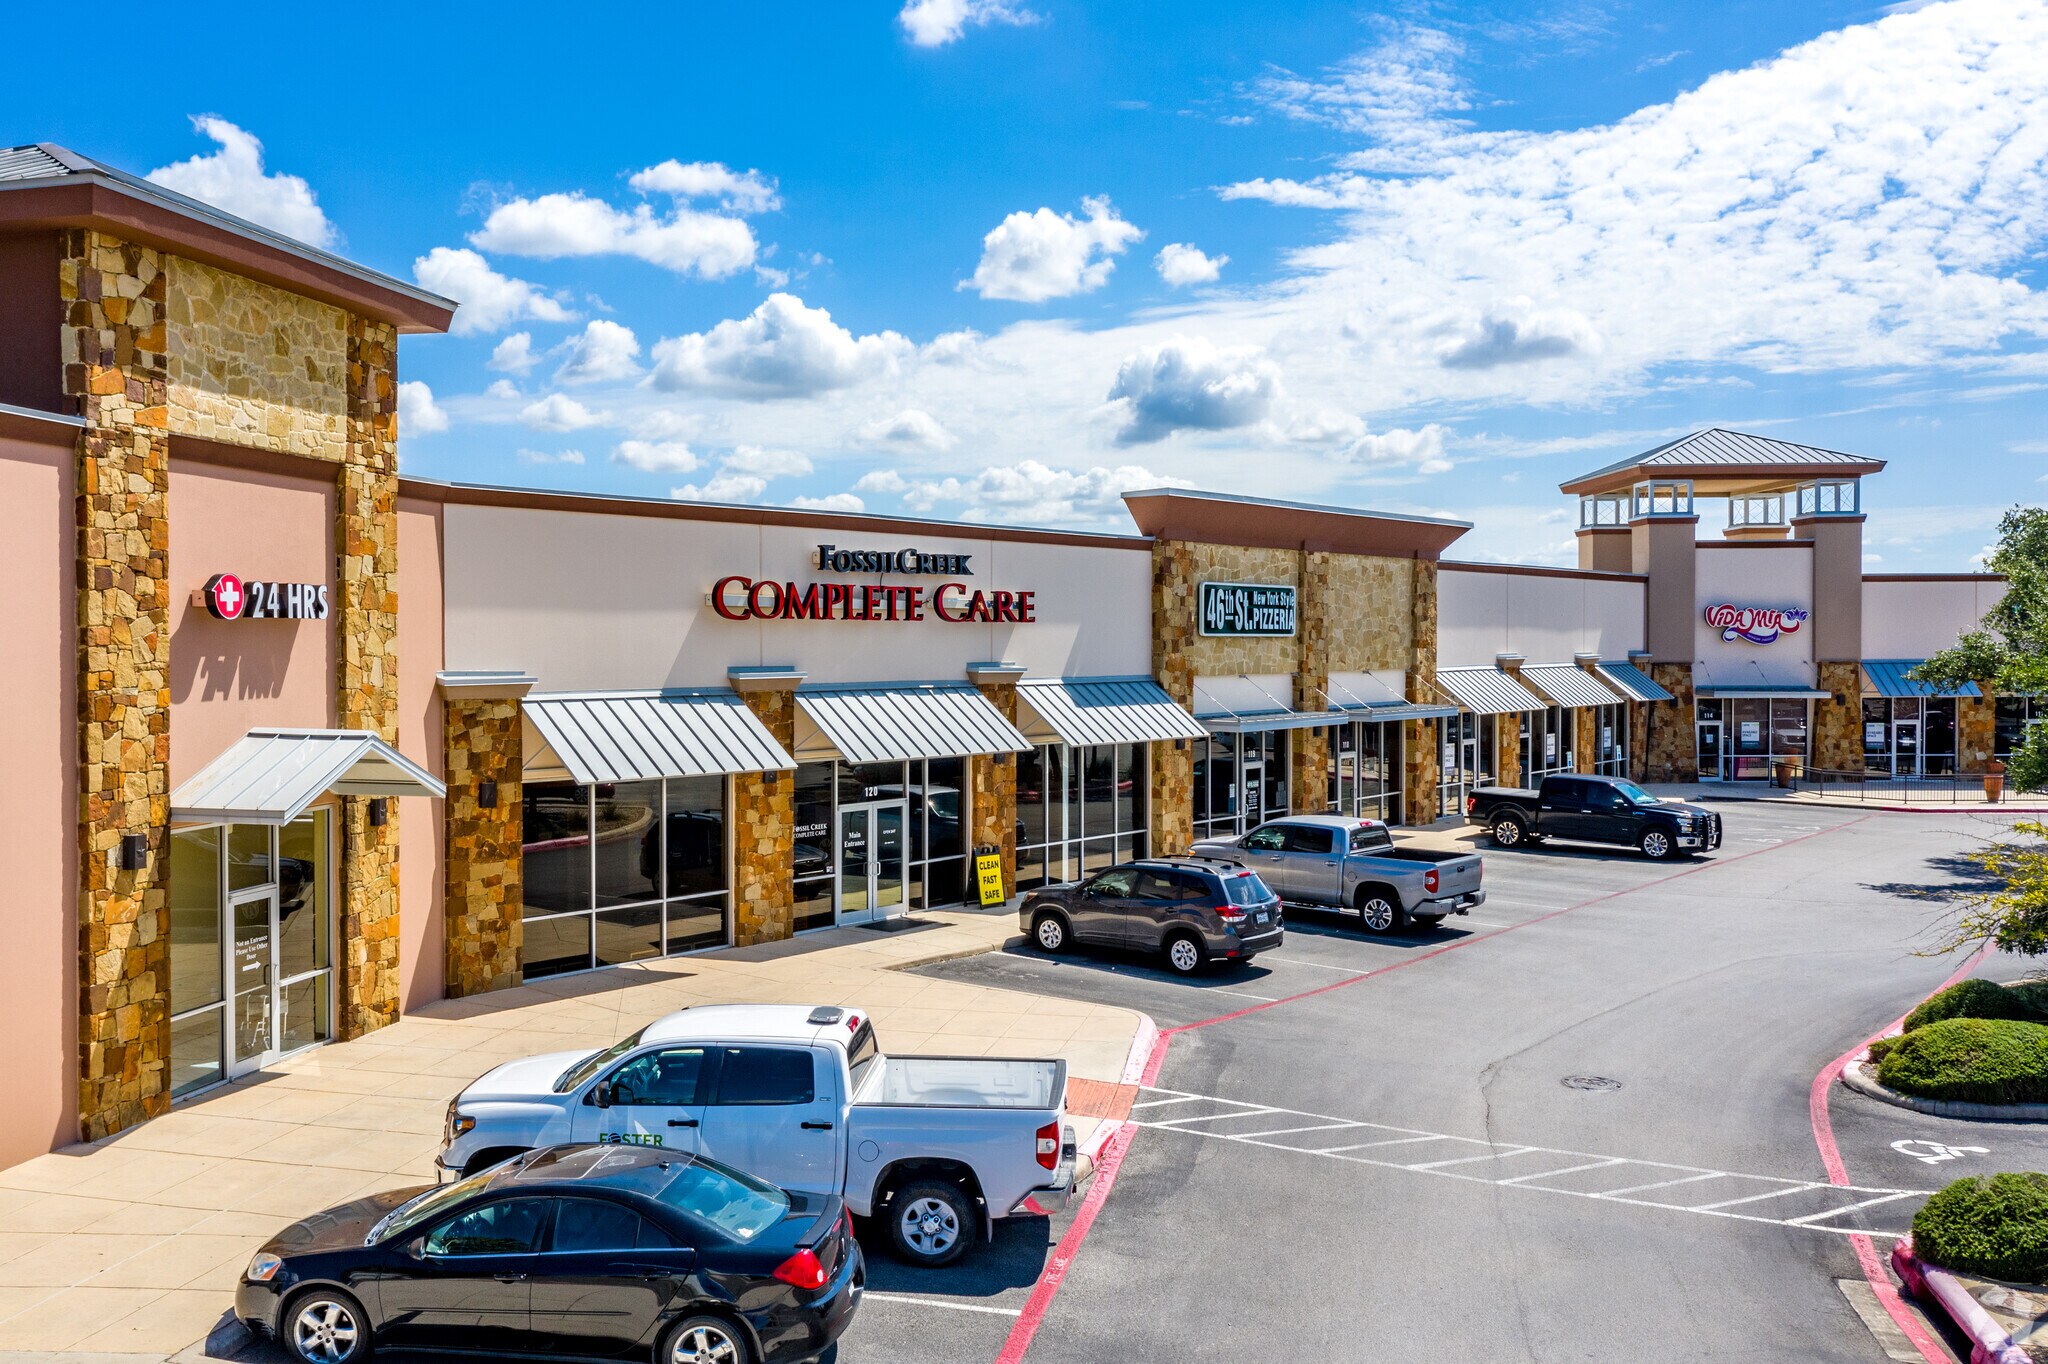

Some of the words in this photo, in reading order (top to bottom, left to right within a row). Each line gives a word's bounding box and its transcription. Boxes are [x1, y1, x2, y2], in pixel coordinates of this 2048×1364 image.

[252, 581, 280, 619] 24
[287, 583, 329, 620] HRS
[711, 575, 925, 621] COMPLETE
[933, 583, 1036, 623] CARE
[1253, 590, 1266, 606] New
[1266, 591, 1279, 606] York
[1280, 591, 1295, 609] Style
[1207, 588, 1234, 630] 46th
[1235, 588, 1253, 631] St.
[1253, 607, 1295, 630] PIZZERIA
[865, 786, 878, 797] 120
[810, 823, 828, 831] CREEK
[848, 831, 861, 839] Main
[844, 840, 865, 848] Entrance
[979, 860, 999, 870] CLEAN
[983, 875, 998, 885] FAST
[985, 889, 1000, 899] SAFE
[250, 935, 268, 944] Entrance
[236, 948, 248, 956] Please
[256, 942, 268, 950] Other
